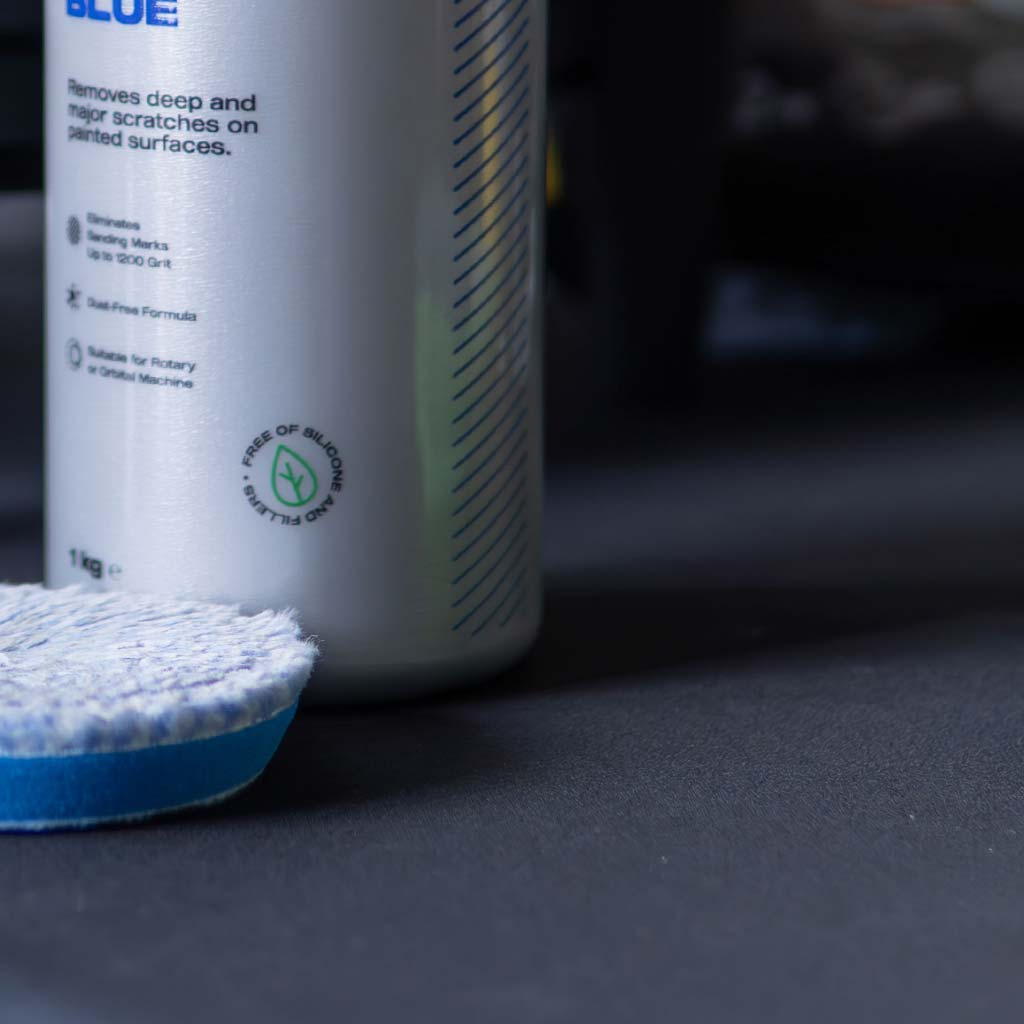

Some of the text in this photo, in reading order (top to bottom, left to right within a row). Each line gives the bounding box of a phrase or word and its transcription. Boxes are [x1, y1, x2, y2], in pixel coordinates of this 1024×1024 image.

[68, 78, 257, 113] Removes deep and
[68, 102, 259, 134] major scratches on
[68, 125, 232, 156] painted surfaces.
[131, 238, 169, 252] Marks
[116, 253, 144, 267] 1200
[147, 257, 172, 269] Grit
[142, 306, 197, 322] Formula
[131, 354, 148, 367] for
[151, 357, 196, 374] Rotary
[139, 373, 194, 389] Machine
[241, 424, 344, 526] FREE OF SILICONE AND FILLERS
